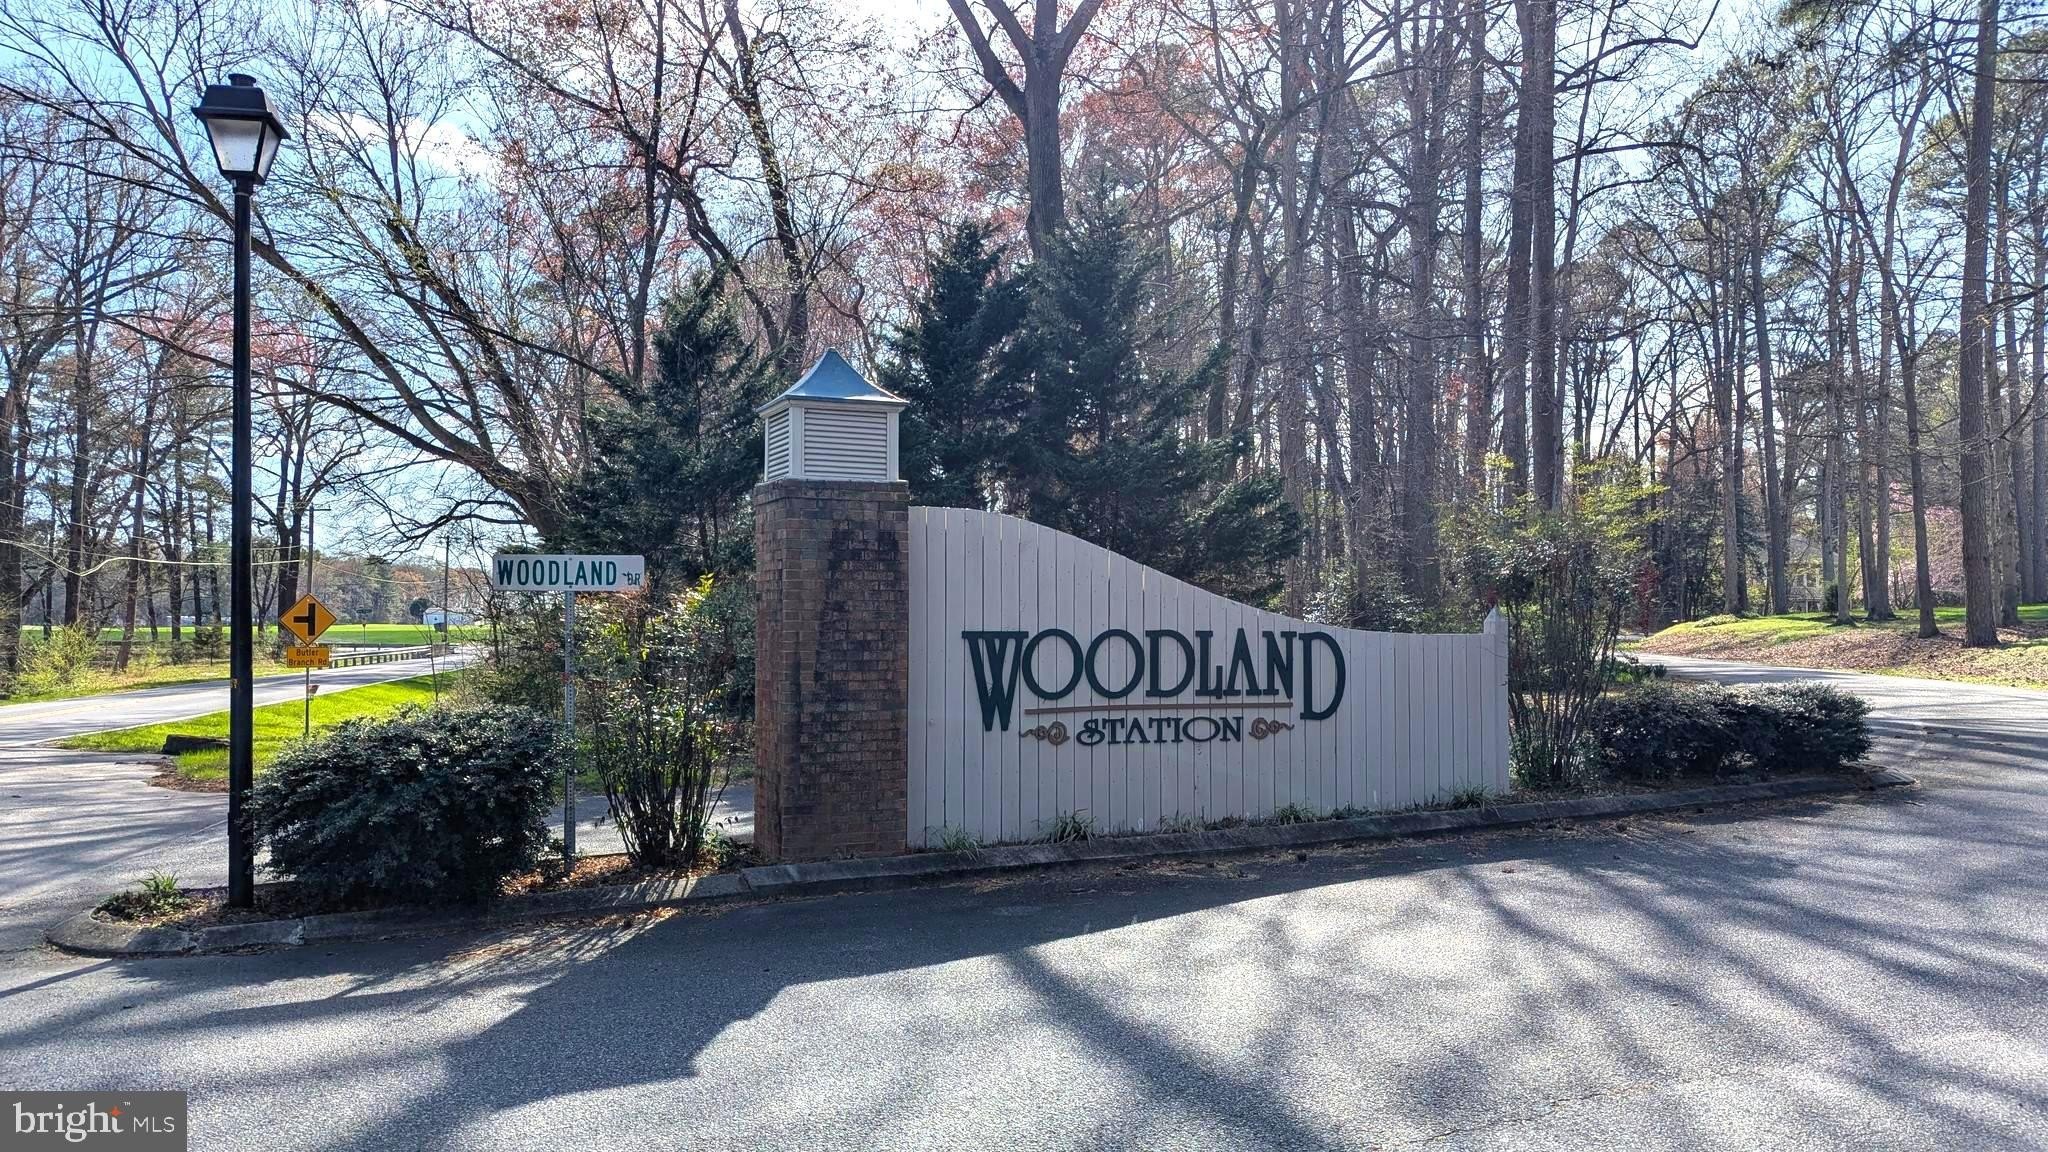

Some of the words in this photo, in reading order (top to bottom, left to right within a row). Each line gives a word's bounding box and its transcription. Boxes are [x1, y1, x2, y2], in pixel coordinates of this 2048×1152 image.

[497, 559, 617, 586] WOODLAND
[627, 572, 641, 586] DR
[288, 658, 315, 666] Branch
[317, 658, 327, 666] Rd
[296, 649, 319, 657] Butler
[961, 628, 1346, 732] WOODLAND
[1076, 716, 1244, 746] STATION
